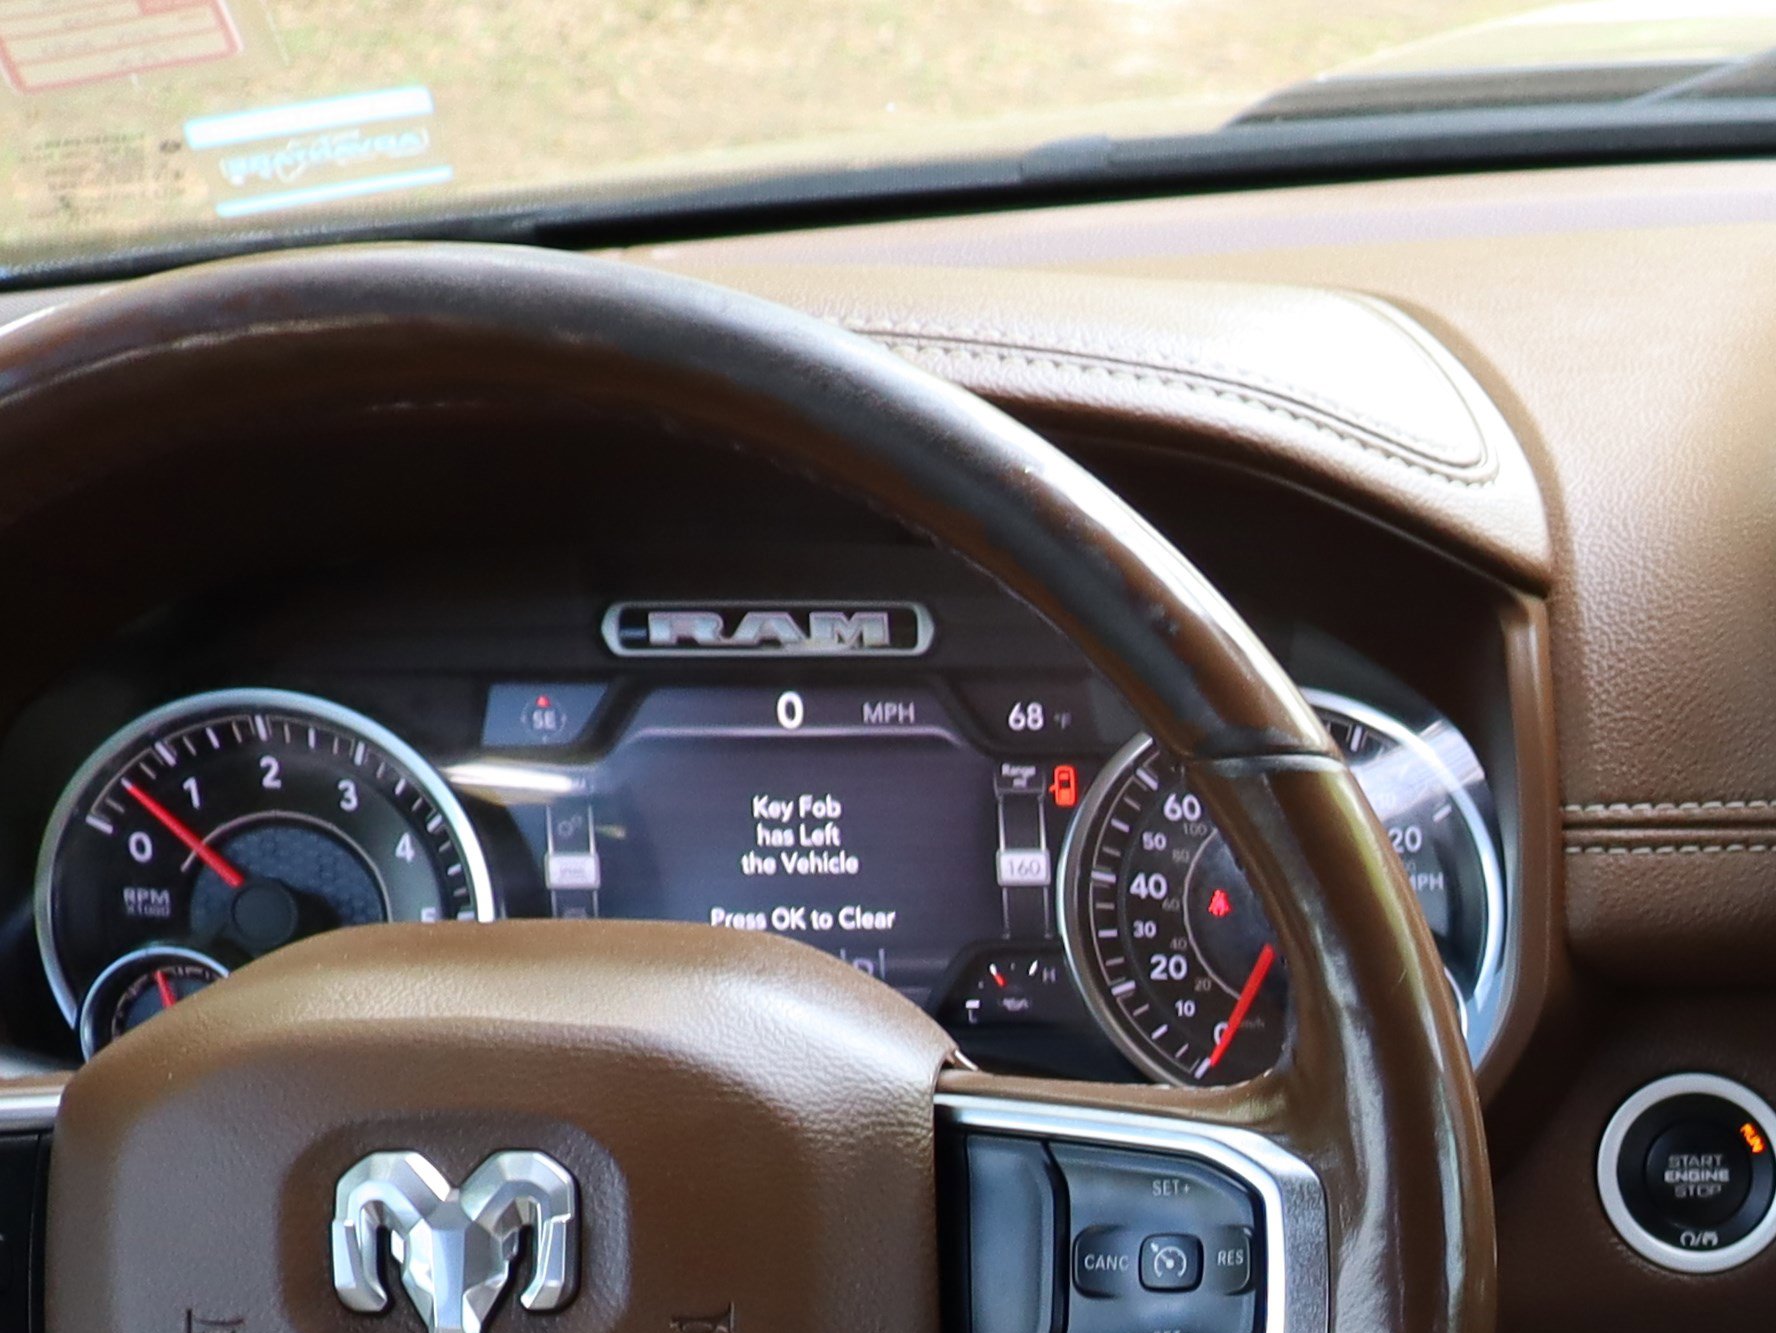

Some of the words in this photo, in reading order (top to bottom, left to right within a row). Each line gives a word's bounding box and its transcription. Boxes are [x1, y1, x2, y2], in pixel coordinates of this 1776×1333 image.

[647, 610, 890, 647] RAM
[776, 691, 804, 729] 0
[863, 701, 915, 725] MPH
[1008, 702, 1044, 731] 68
[259, 757, 283, 789] 2
[182, 777, 202, 808] 1
[338, 779, 360, 811] 3
[752, 795, 794, 820] Key
[799, 794, 842, 819] Fob
[1164, 795, 1201, 821] 60
[128, 831, 154, 864] 0
[756, 823, 794, 847] has
[798, 823, 841, 847] Left
[1142, 833, 1166, 851] 50
[1388, 826, 1422, 853] 20
[394, 832, 415, 864] 4
[741, 851, 777, 875] the
[780, 851, 859, 875] Vehicle
[1008, 859, 1041, 877] 160
[123, 886, 172, 904] RPM
[1130, 873, 1167, 899] 40
[710, 907, 767, 929] Press
[771, 907, 806, 930] OK
[810, 908, 832, 930] to
[838, 906, 896, 930] Clear
[1133, 920, 1157, 939] 30
[1150, 954, 1188, 980] 20
[1175, 1001, 1196, 1017] 10
[1668, 1154, 1723, 1168] START
[1664, 1168, 1730, 1183] ENGINE
[1674, 1183, 1722, 1198] STOP
[1084, 1252, 1130, 1272] CANC
[1217, 1249, 1244, 1268] RES
